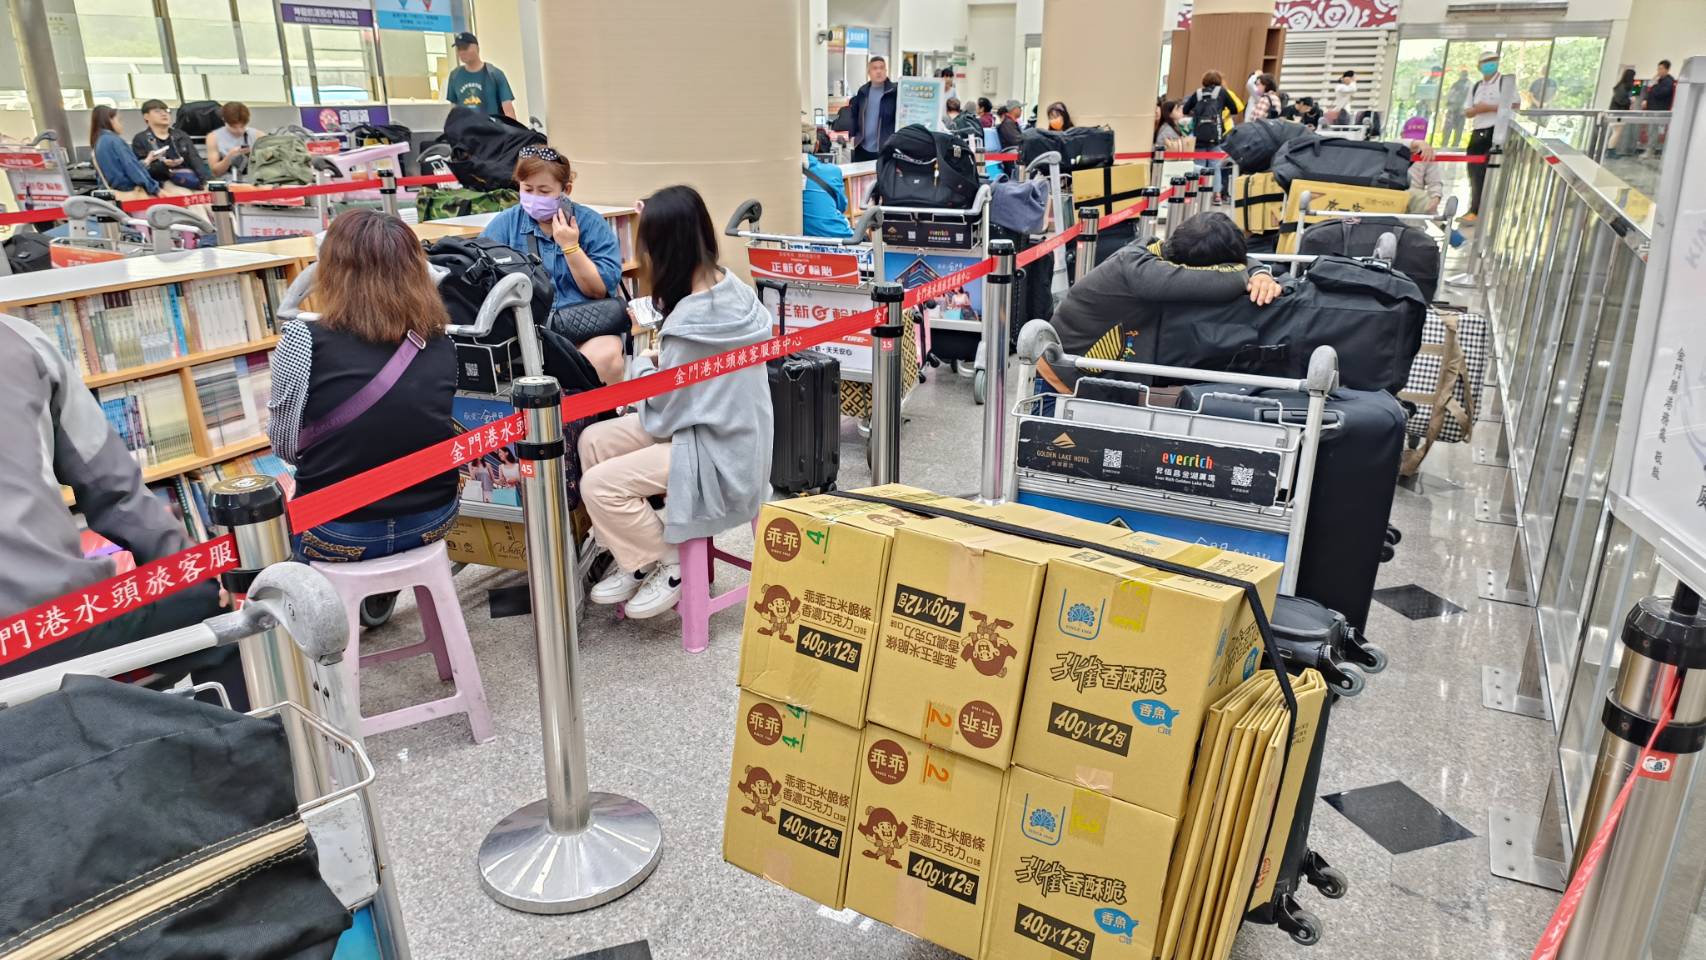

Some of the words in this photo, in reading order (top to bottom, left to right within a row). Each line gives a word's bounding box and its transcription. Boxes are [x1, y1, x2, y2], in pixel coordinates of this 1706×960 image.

[882, 340, 893, 349] 15
[674, 335, 803, 386] 金門港水頭旅客服務中心
[521, 463, 533, 475] 45
[1036, 449, 1057, 459] GOLDEN
[1058, 453, 1072, 461] LAKE
[1073, 455, 1090, 464] HOTEL
[1162, 452, 1214, 470] everrich
[766, 527, 799, 551] 乖乖
[803, 589, 873, 621] 乖乖玉米脆條
[1050, 651, 1168, 694] 孔雀香酥脆
[749, 711, 781, 736] 乖乖
[1139, 703, 1166, 721] 香魚
[870, 748, 906, 774] 乖乖
[784, 773, 850, 809] 乖乖玉米脆條
[910, 814, 986, 852] 乖乖玉米脆條
[1015, 855, 1127, 905] 孔雀香酥脆
[1100, 910, 1128, 930] 香魚
